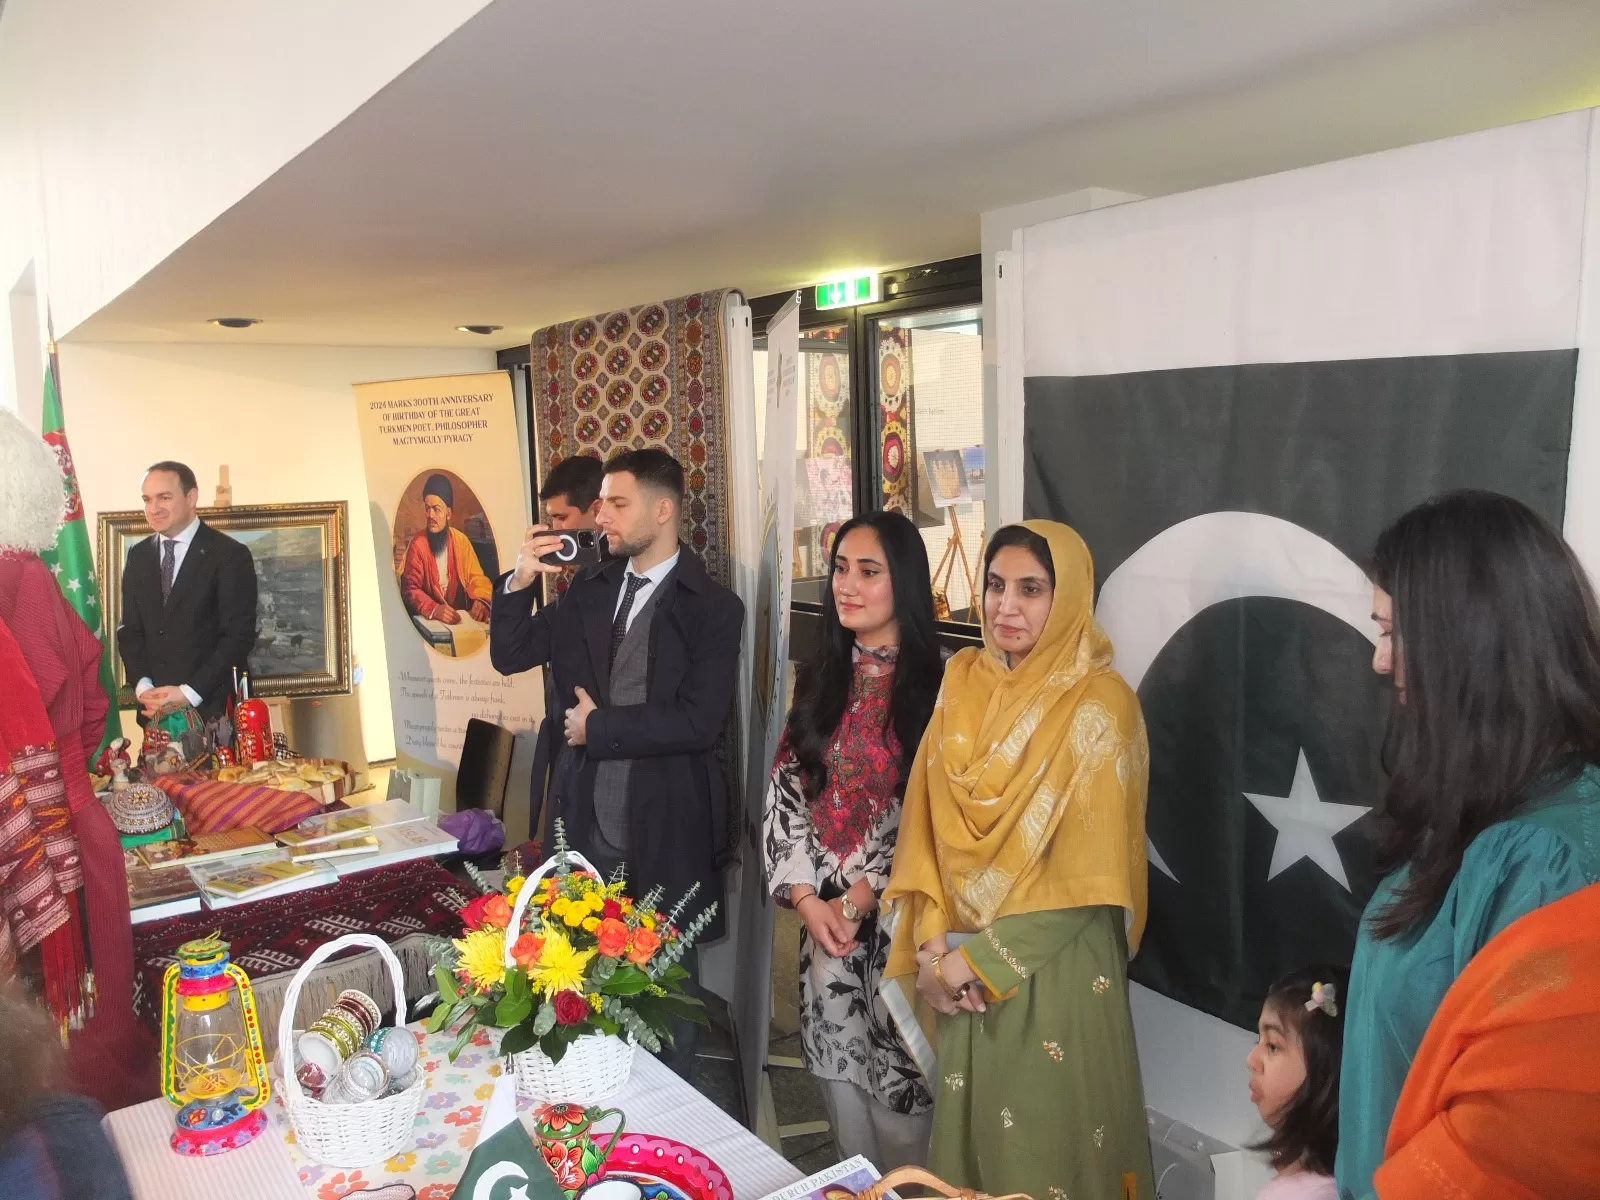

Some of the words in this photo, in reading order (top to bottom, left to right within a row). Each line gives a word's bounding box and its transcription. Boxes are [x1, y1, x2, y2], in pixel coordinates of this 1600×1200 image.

[370, 401, 387, 410] 2024
[387, 399, 412, 409] MARKS
[413, 397, 439, 408] 300TH
[440, 393, 494, 405] ANNIVERSARY
[382, 413, 391, 421] OF
[392, 411, 426, 421] BIRTHDAY
[427, 410, 438, 419] OF
[439, 408, 454, 418] THE
[455, 407, 481, 417] GREAT
[379, 424, 412, 434] TURKMEN
[435, 420, 488, 431] PHILOSOPHER
[393, 435, 442, 446] MAGTYMGULY
[444, 433, 474, 444] PYRAGY
[771, 1183, 810, 1200] DURCH
[811, 1157, 864, 1187] PAKISTAN
